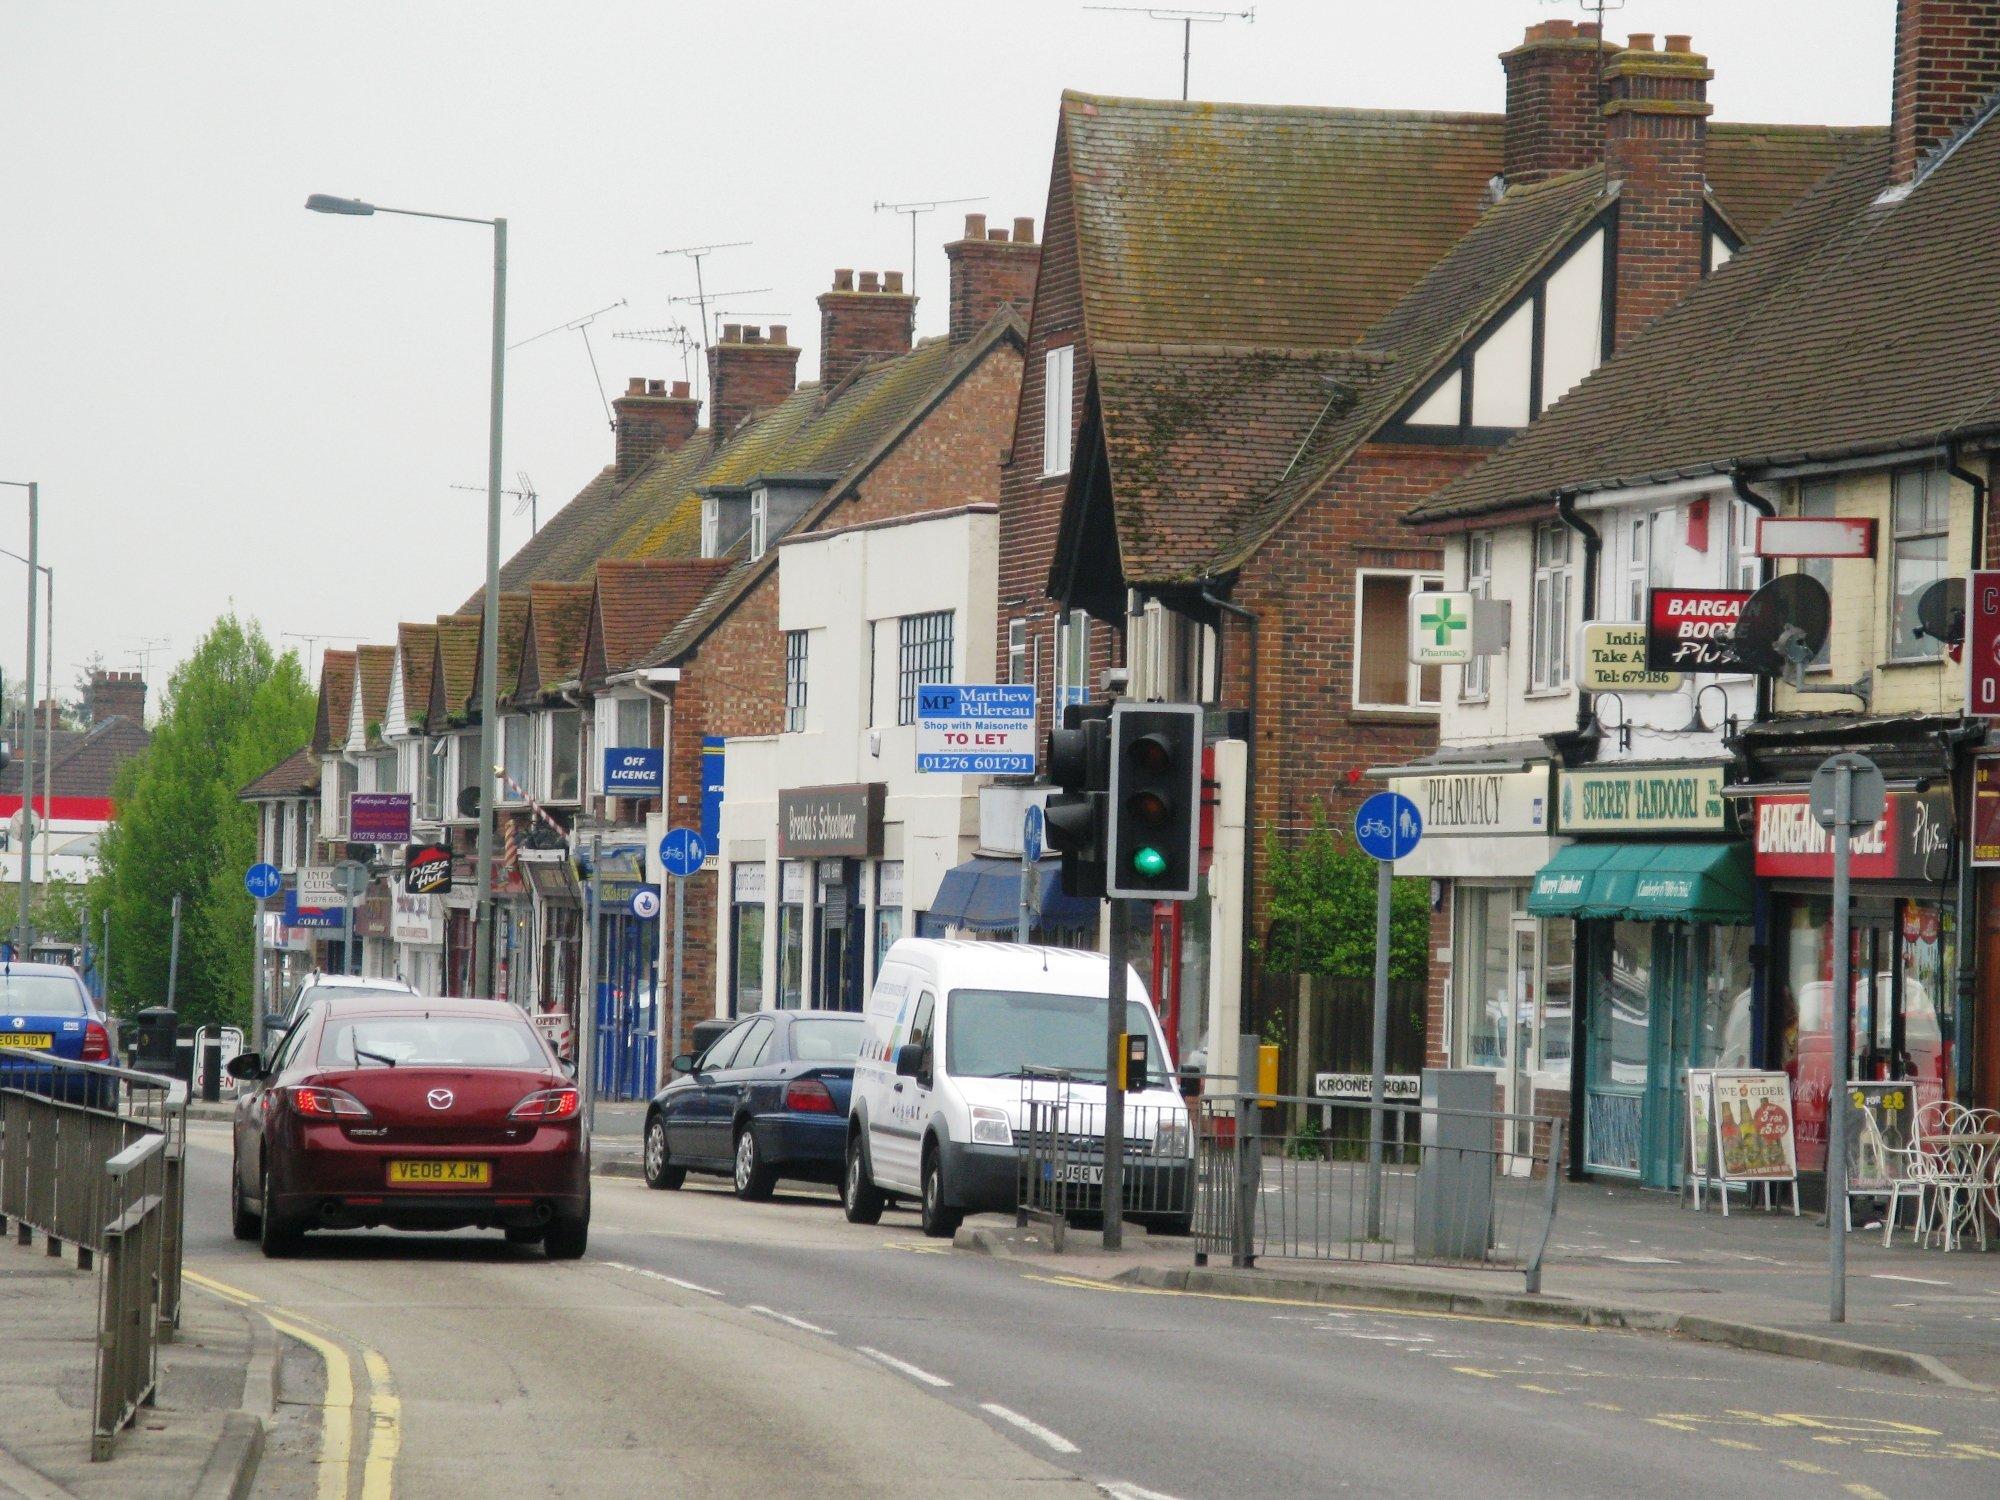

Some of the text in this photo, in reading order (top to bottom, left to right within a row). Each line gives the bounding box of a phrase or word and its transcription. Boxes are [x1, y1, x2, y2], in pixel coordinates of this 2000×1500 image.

[1605, 632, 1646, 645] India
[1421, 647, 1466, 658] Pharmacy
[1592, 649, 1627, 663] Take
[1595, 670, 1669, 683] Tel: 679186
[959, 688, 1032, 702] Matthew
[921, 695, 955, 710] MP
[960, 702, 1030, 716] Pellereau
[924, 721, 1029, 731] Shop with Maisonette
[944, 733, 1008, 745] TO LET
[623, 756, 646, 766] OFF
[923, 756, 1028, 770] 01276 601791
[611, 770, 656, 780] LICENCE
[1428, 776, 1503, 825] PHARMACY
[1583, 780, 1632, 820] SURREY
[1635, 778, 1699, 820] TANDOORI
[307, 871, 331, 880] IND
[409, 860, 449, 885] Pizza
[416, 869, 446, 889] Hut
[304, 881, 335, 889] CUIS
[297, 917, 332, 926] CORAL
[536, 1017, 562, 1026] OPEN
[1385, 1080, 1418, 1094] ROAD
[1720, 1086, 1784, 1096] WE CIDER
[1853, 1091, 1865, 1109] 2
[1866, 1096, 1881, 1106] FOR
[1760, 1110, 1783, 1123] 3 FOR
[399, 1163, 481, 1179] VE08 XJM
